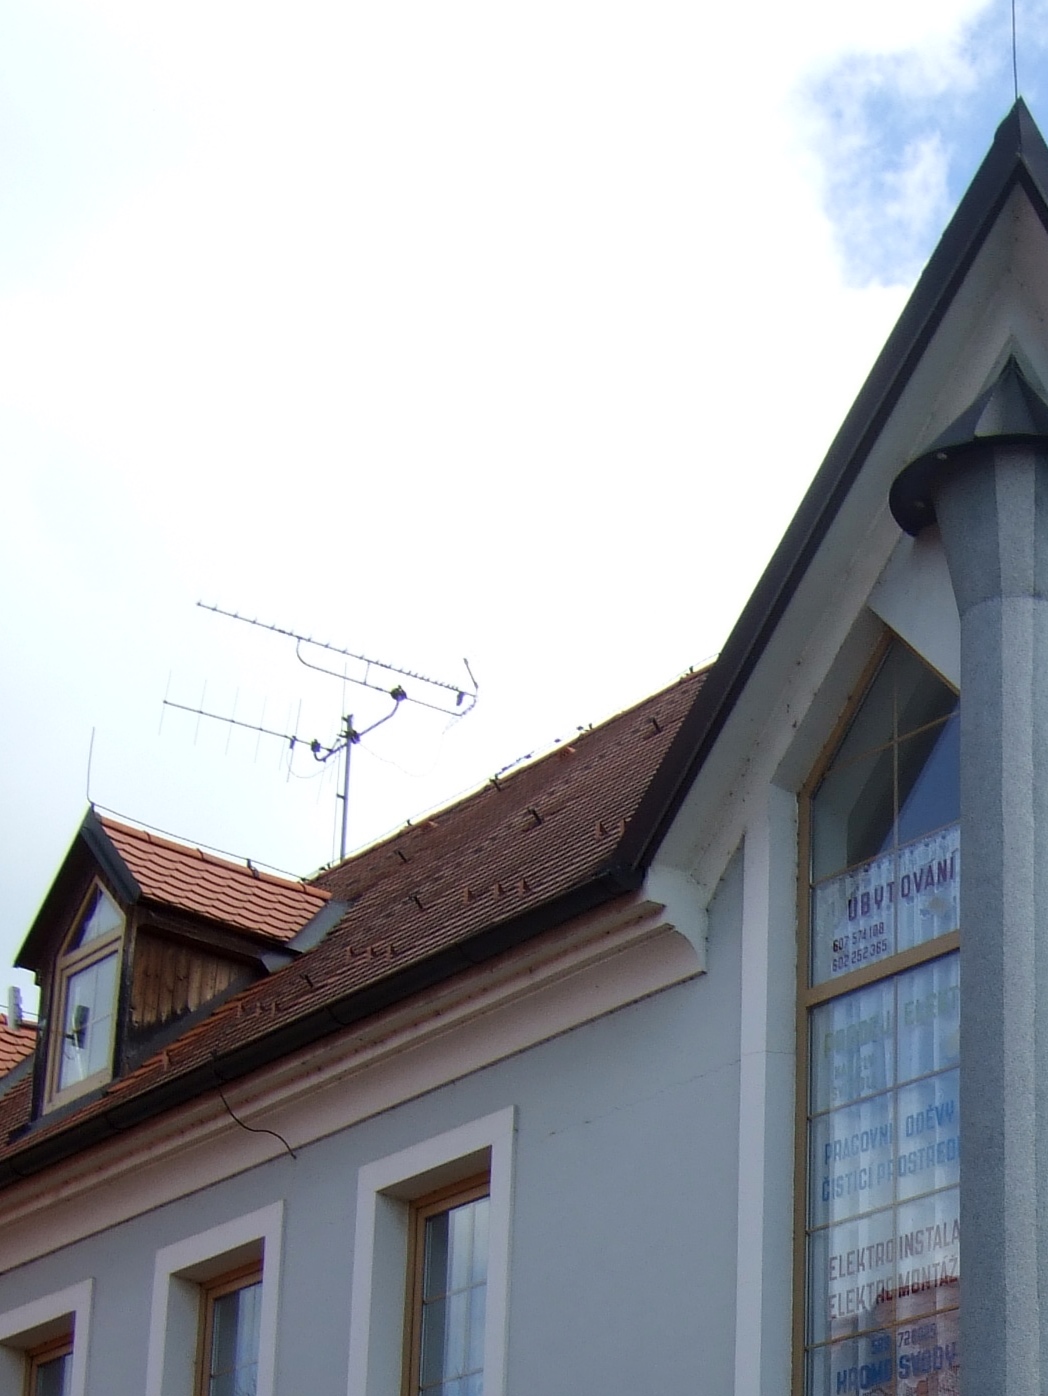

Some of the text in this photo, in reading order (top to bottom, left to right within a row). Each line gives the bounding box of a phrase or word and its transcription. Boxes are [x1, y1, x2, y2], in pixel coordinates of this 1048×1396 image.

[905, 1099, 956, 1138] ODĚVY
[829, 1217, 960, 1281] ELEKTRO INSTALA
[828, 1253, 960, 1320] ELEKTRO MONTÁŽ
